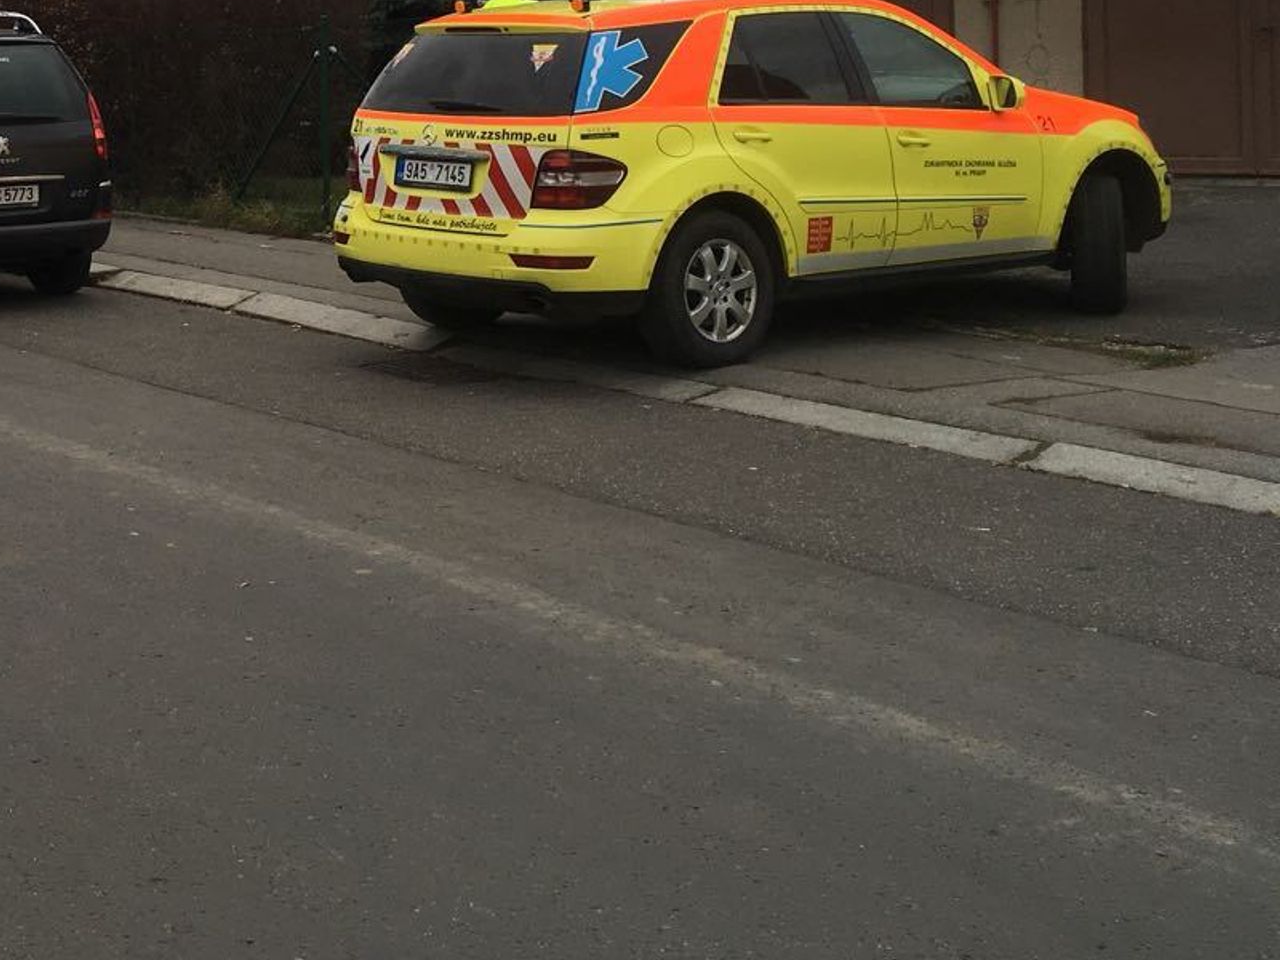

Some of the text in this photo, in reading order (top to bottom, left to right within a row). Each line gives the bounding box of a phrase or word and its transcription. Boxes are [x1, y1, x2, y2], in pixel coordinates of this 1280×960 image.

[1037, 115, 1055, 131] 21
[445, 127, 557, 143] www.zzshmp.eu
[405, 161, 466, 184] 9A5 7145
[5, 186, 34, 202] 5773
